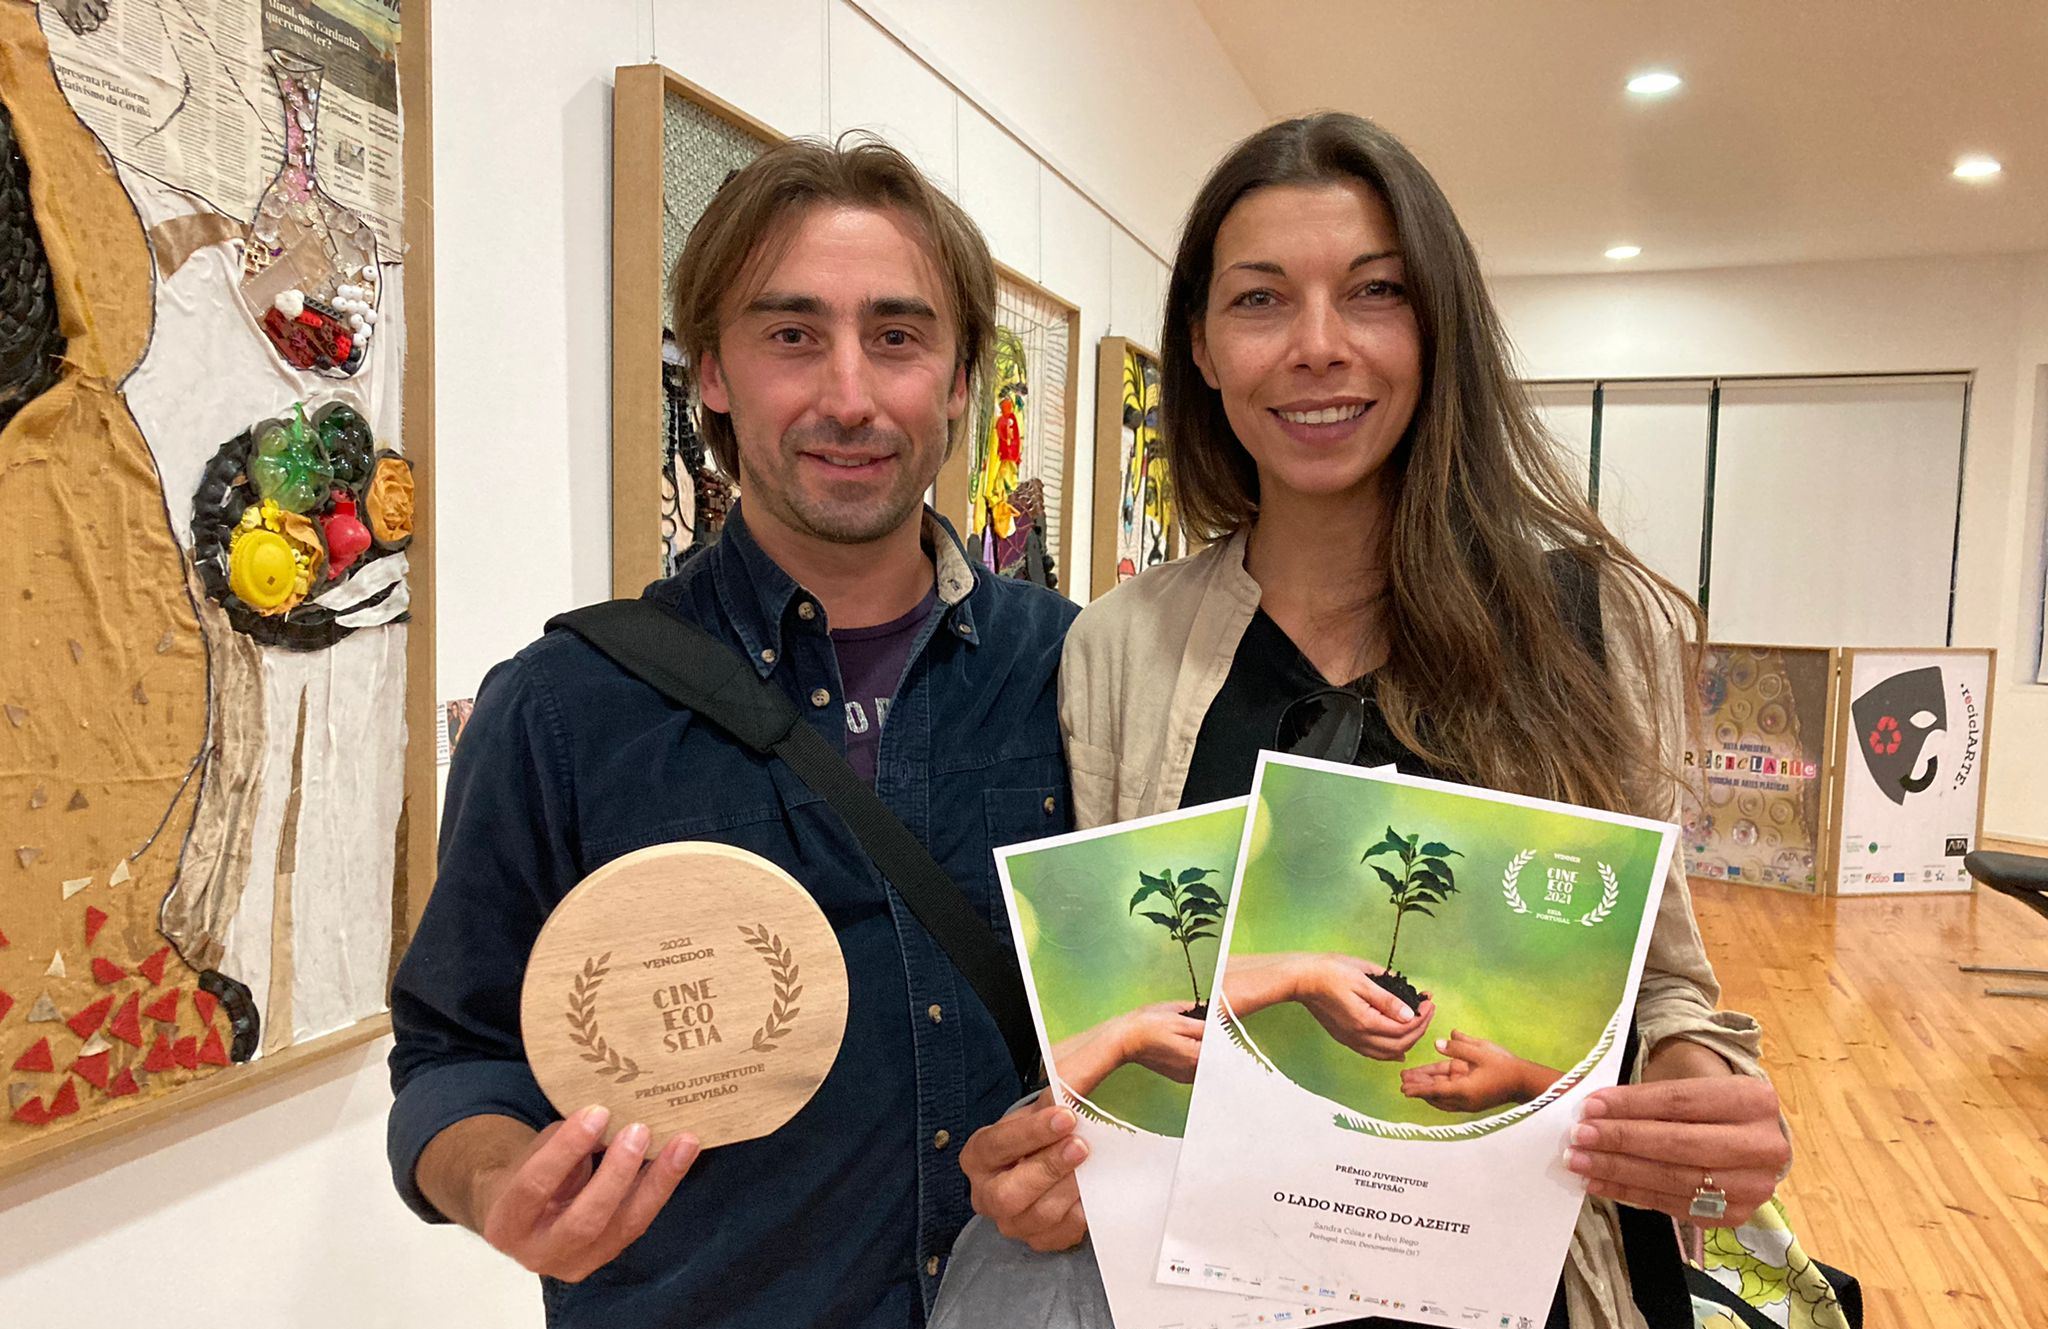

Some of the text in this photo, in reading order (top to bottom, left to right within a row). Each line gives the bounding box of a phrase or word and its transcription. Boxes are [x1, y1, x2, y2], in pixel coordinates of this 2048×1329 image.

[298, 13, 315, 28] que
[101, 79, 150, 105] Plataforma
[106, 94, 117, 106] da
[1547, 867, 1579, 883] CINE
[1547, 879, 1573, 893] ECO
[1544, 890, 1572, 905] 2021
[1535, 913, 1571, 925] PORTUGAL
[659, 937, 693, 951] 2021
[642, 948, 715, 970] VENCEDOR
[652, 977, 718, 1010] CINE
[662, 1002, 714, 1031] ECO
[662, 1024, 723, 1054] SEIA
[635, 1062, 766, 1100] PRÉMIO JUVENTUDE
[667, 1083, 739, 1107] TELEVISÃO
[1335, 1164, 1429, 1188] PRÉMIO JUVENTUDE
[1354, 1178, 1405, 1194] TELEVISÃO
[1273, 1191, 1471, 1235] O LADO NEGRO DO AZEITE
[1313, 1221, 1342, 1233] Sandra
[1374, 1232, 1397, 1243] Pedro
[1399, 1237, 1419, 1247] Rego
